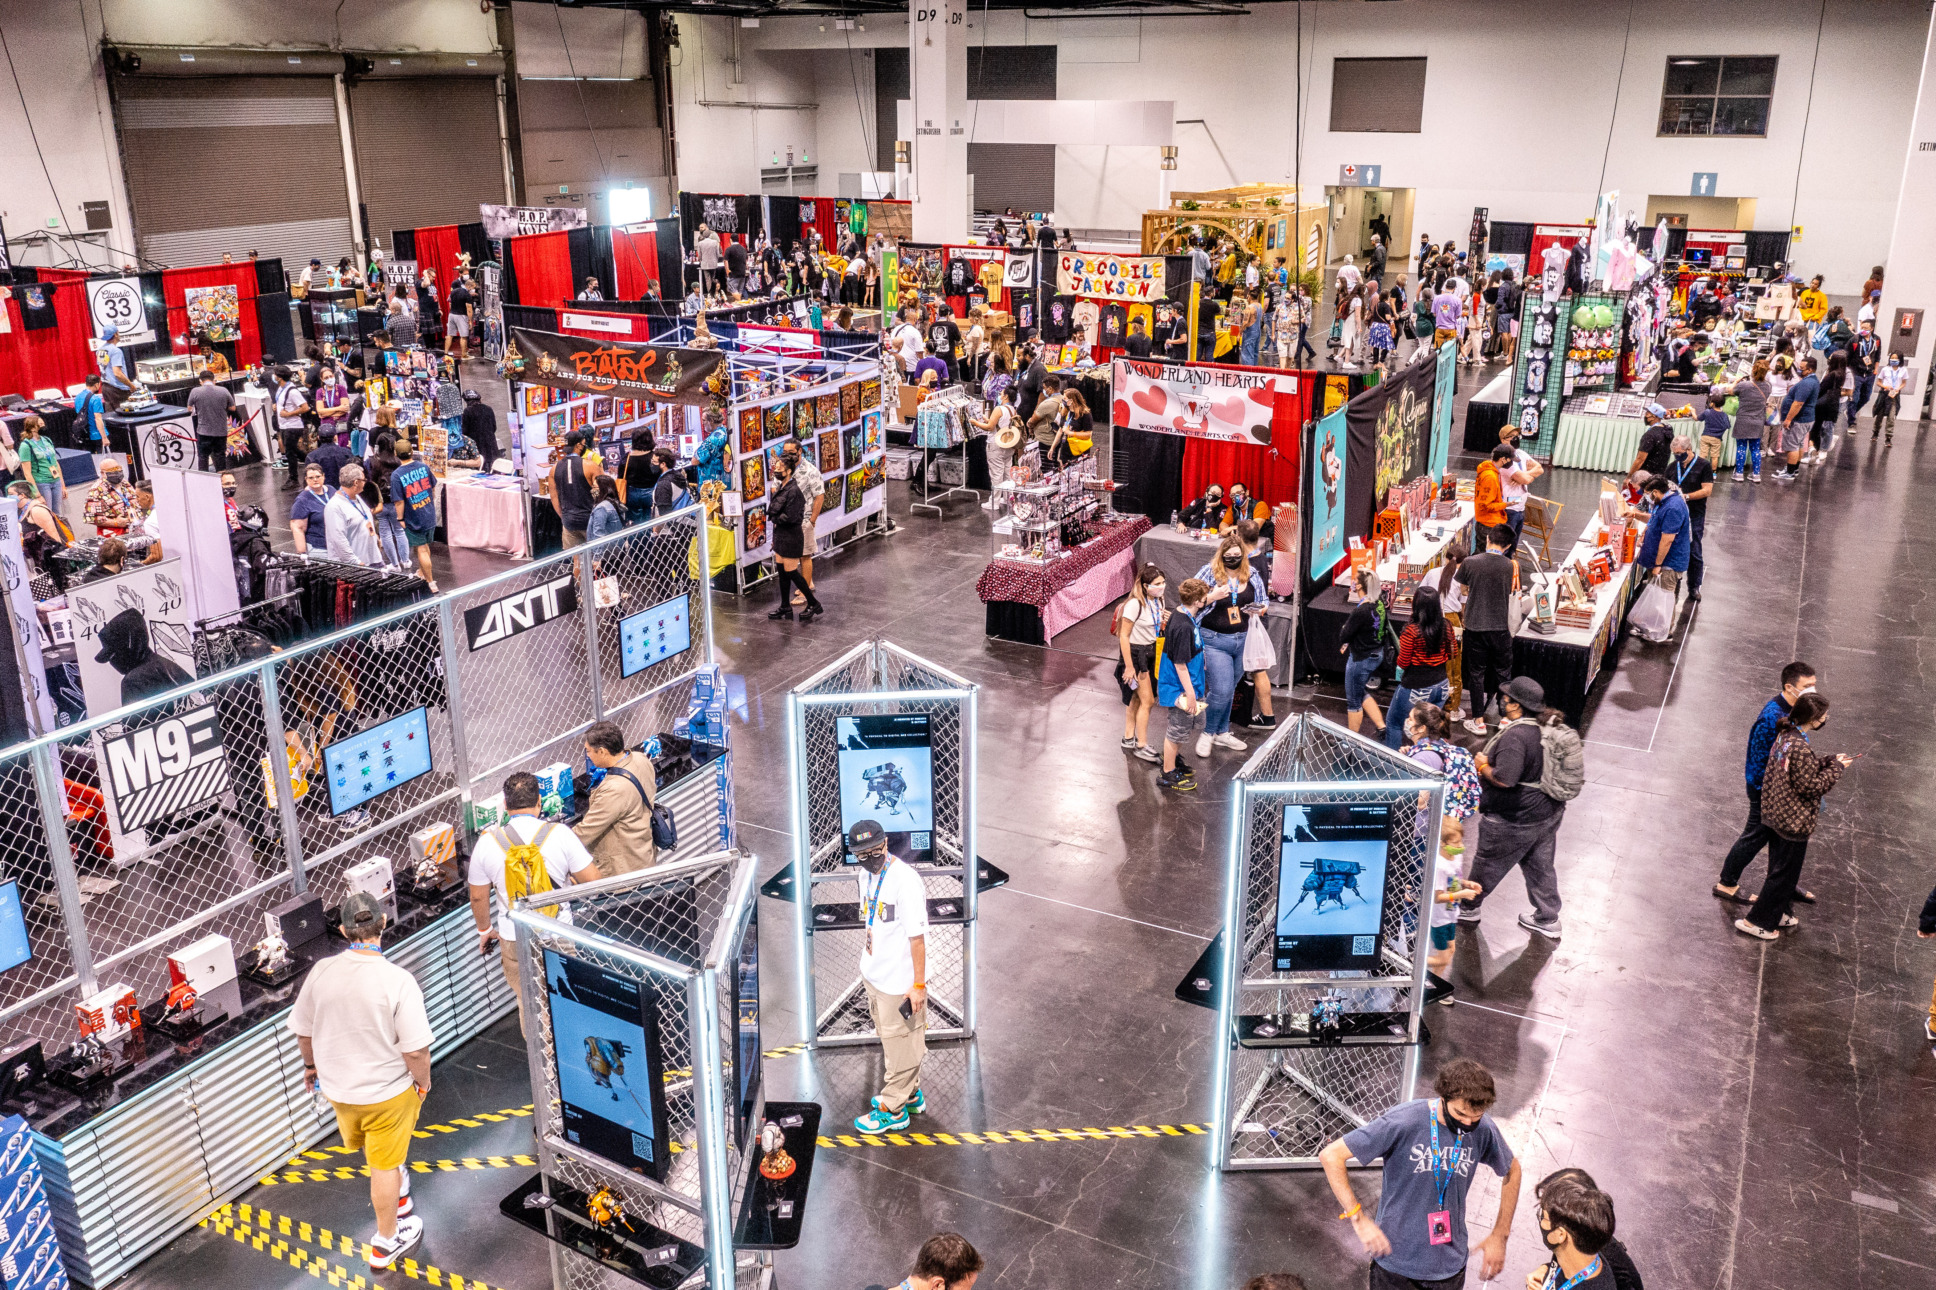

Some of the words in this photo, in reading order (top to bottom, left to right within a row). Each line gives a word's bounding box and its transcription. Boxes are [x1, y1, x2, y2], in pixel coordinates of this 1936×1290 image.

[917, 9, 937, 22] D9
[952, 12, 962, 25] D9
[518, 211, 547, 223] H.O.P.
[387, 265, 414, 274] H.O.P.
[1061, 256, 1163, 279] CROCODILE
[389, 275, 415, 284] TOYS
[1071, 276, 1150, 297] JACKSON
[101, 289, 131, 300] Classic
[104, 298, 132, 319] 33
[556, 372, 575, 380] ART
[576, 374, 594, 382] FOR
[596, 377, 618, 385] YOUR
[620, 380, 654, 390] CUSTOM
[655, 384, 676, 393] LIFE
[1123, 361, 1211, 386] WONDERLAND
[1215, 372, 1267, 390] HEARTS
[1138, 423, 1240, 441] WONDERLANDHEARTS.COM
[400, 466, 429, 488] EXCUSE
[406, 477, 432, 499] ME
